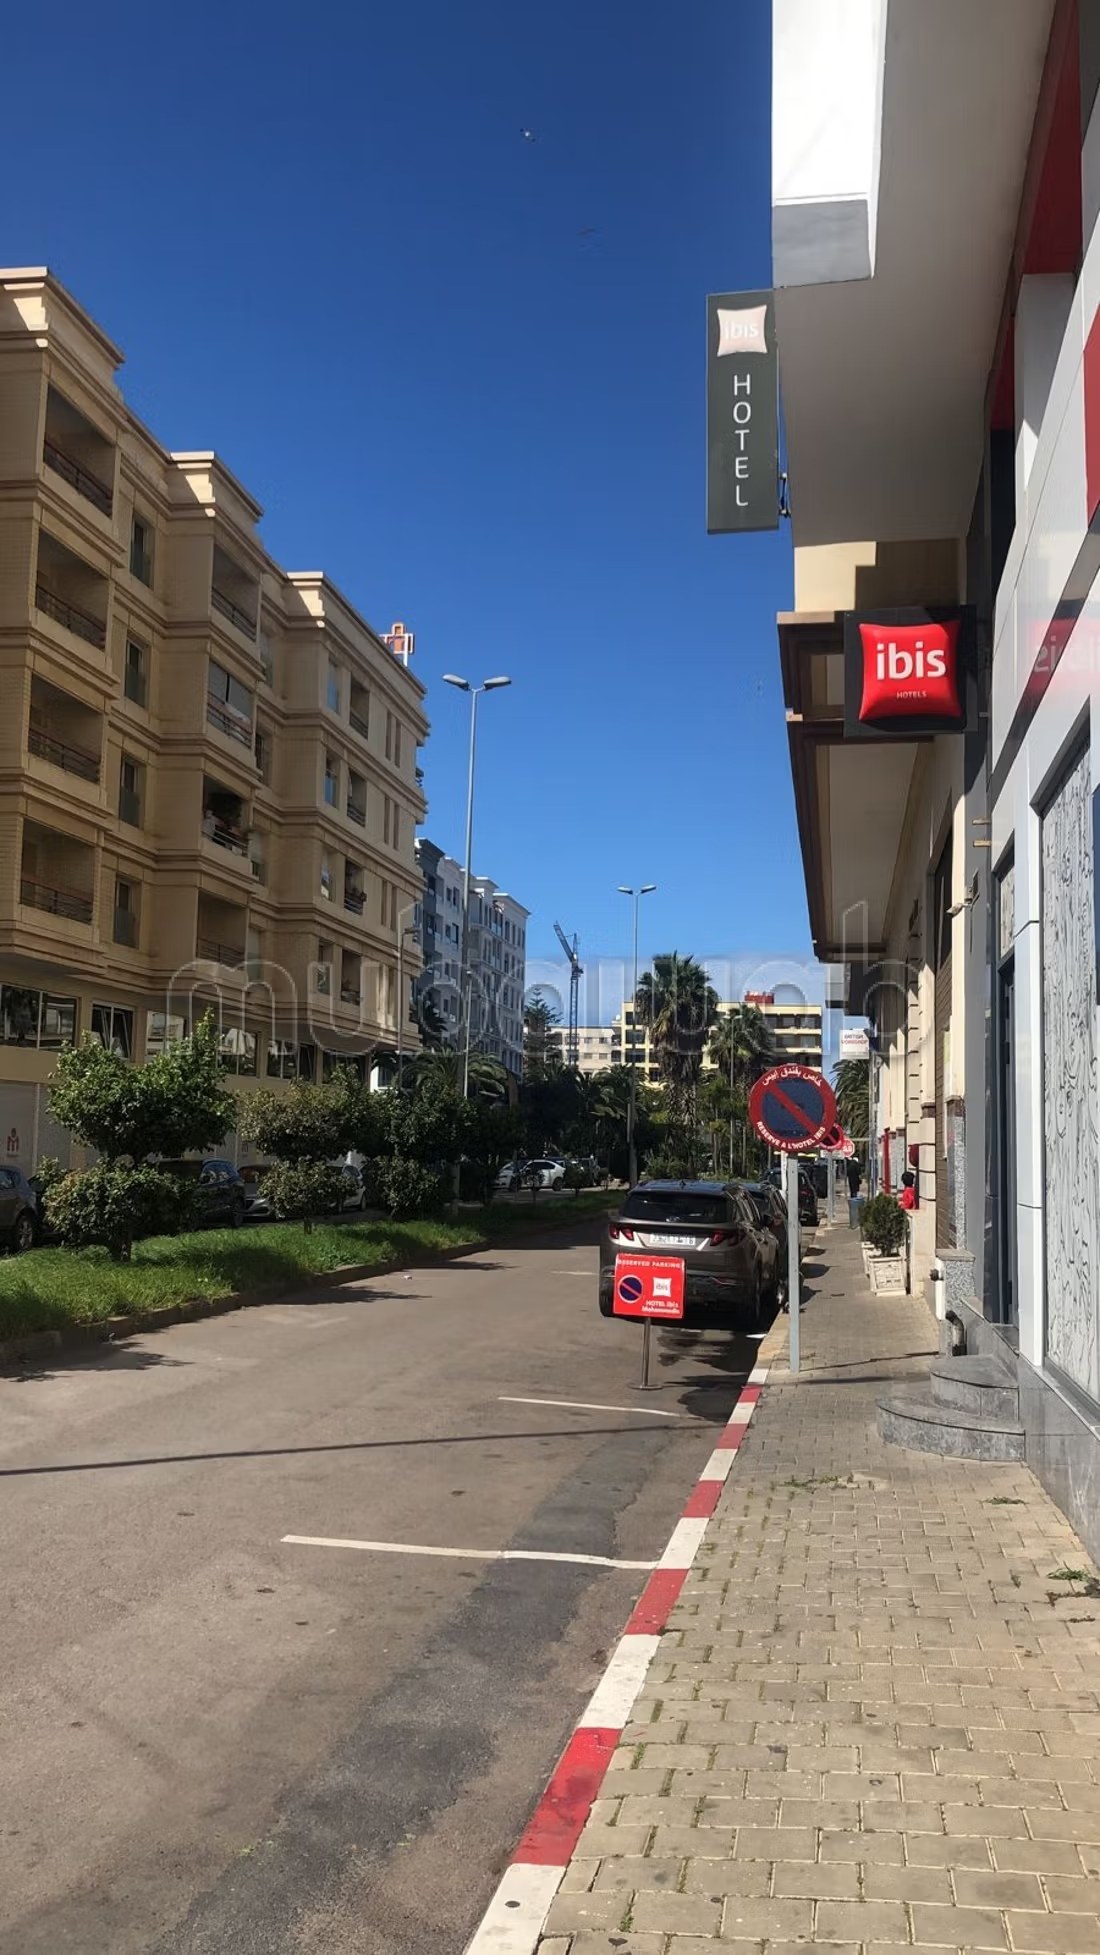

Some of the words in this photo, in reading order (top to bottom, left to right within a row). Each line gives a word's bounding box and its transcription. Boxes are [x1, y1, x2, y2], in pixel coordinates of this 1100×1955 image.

[724, 319, 760, 341] ibis
[733, 373, 752, 506] HOTEL
[876, 641, 947, 680] ibis
[896, 691, 928, 700] HOTELS
[651, 1261, 681, 1269] PARKING
[645, 1300, 665, 1308] HOTEL
